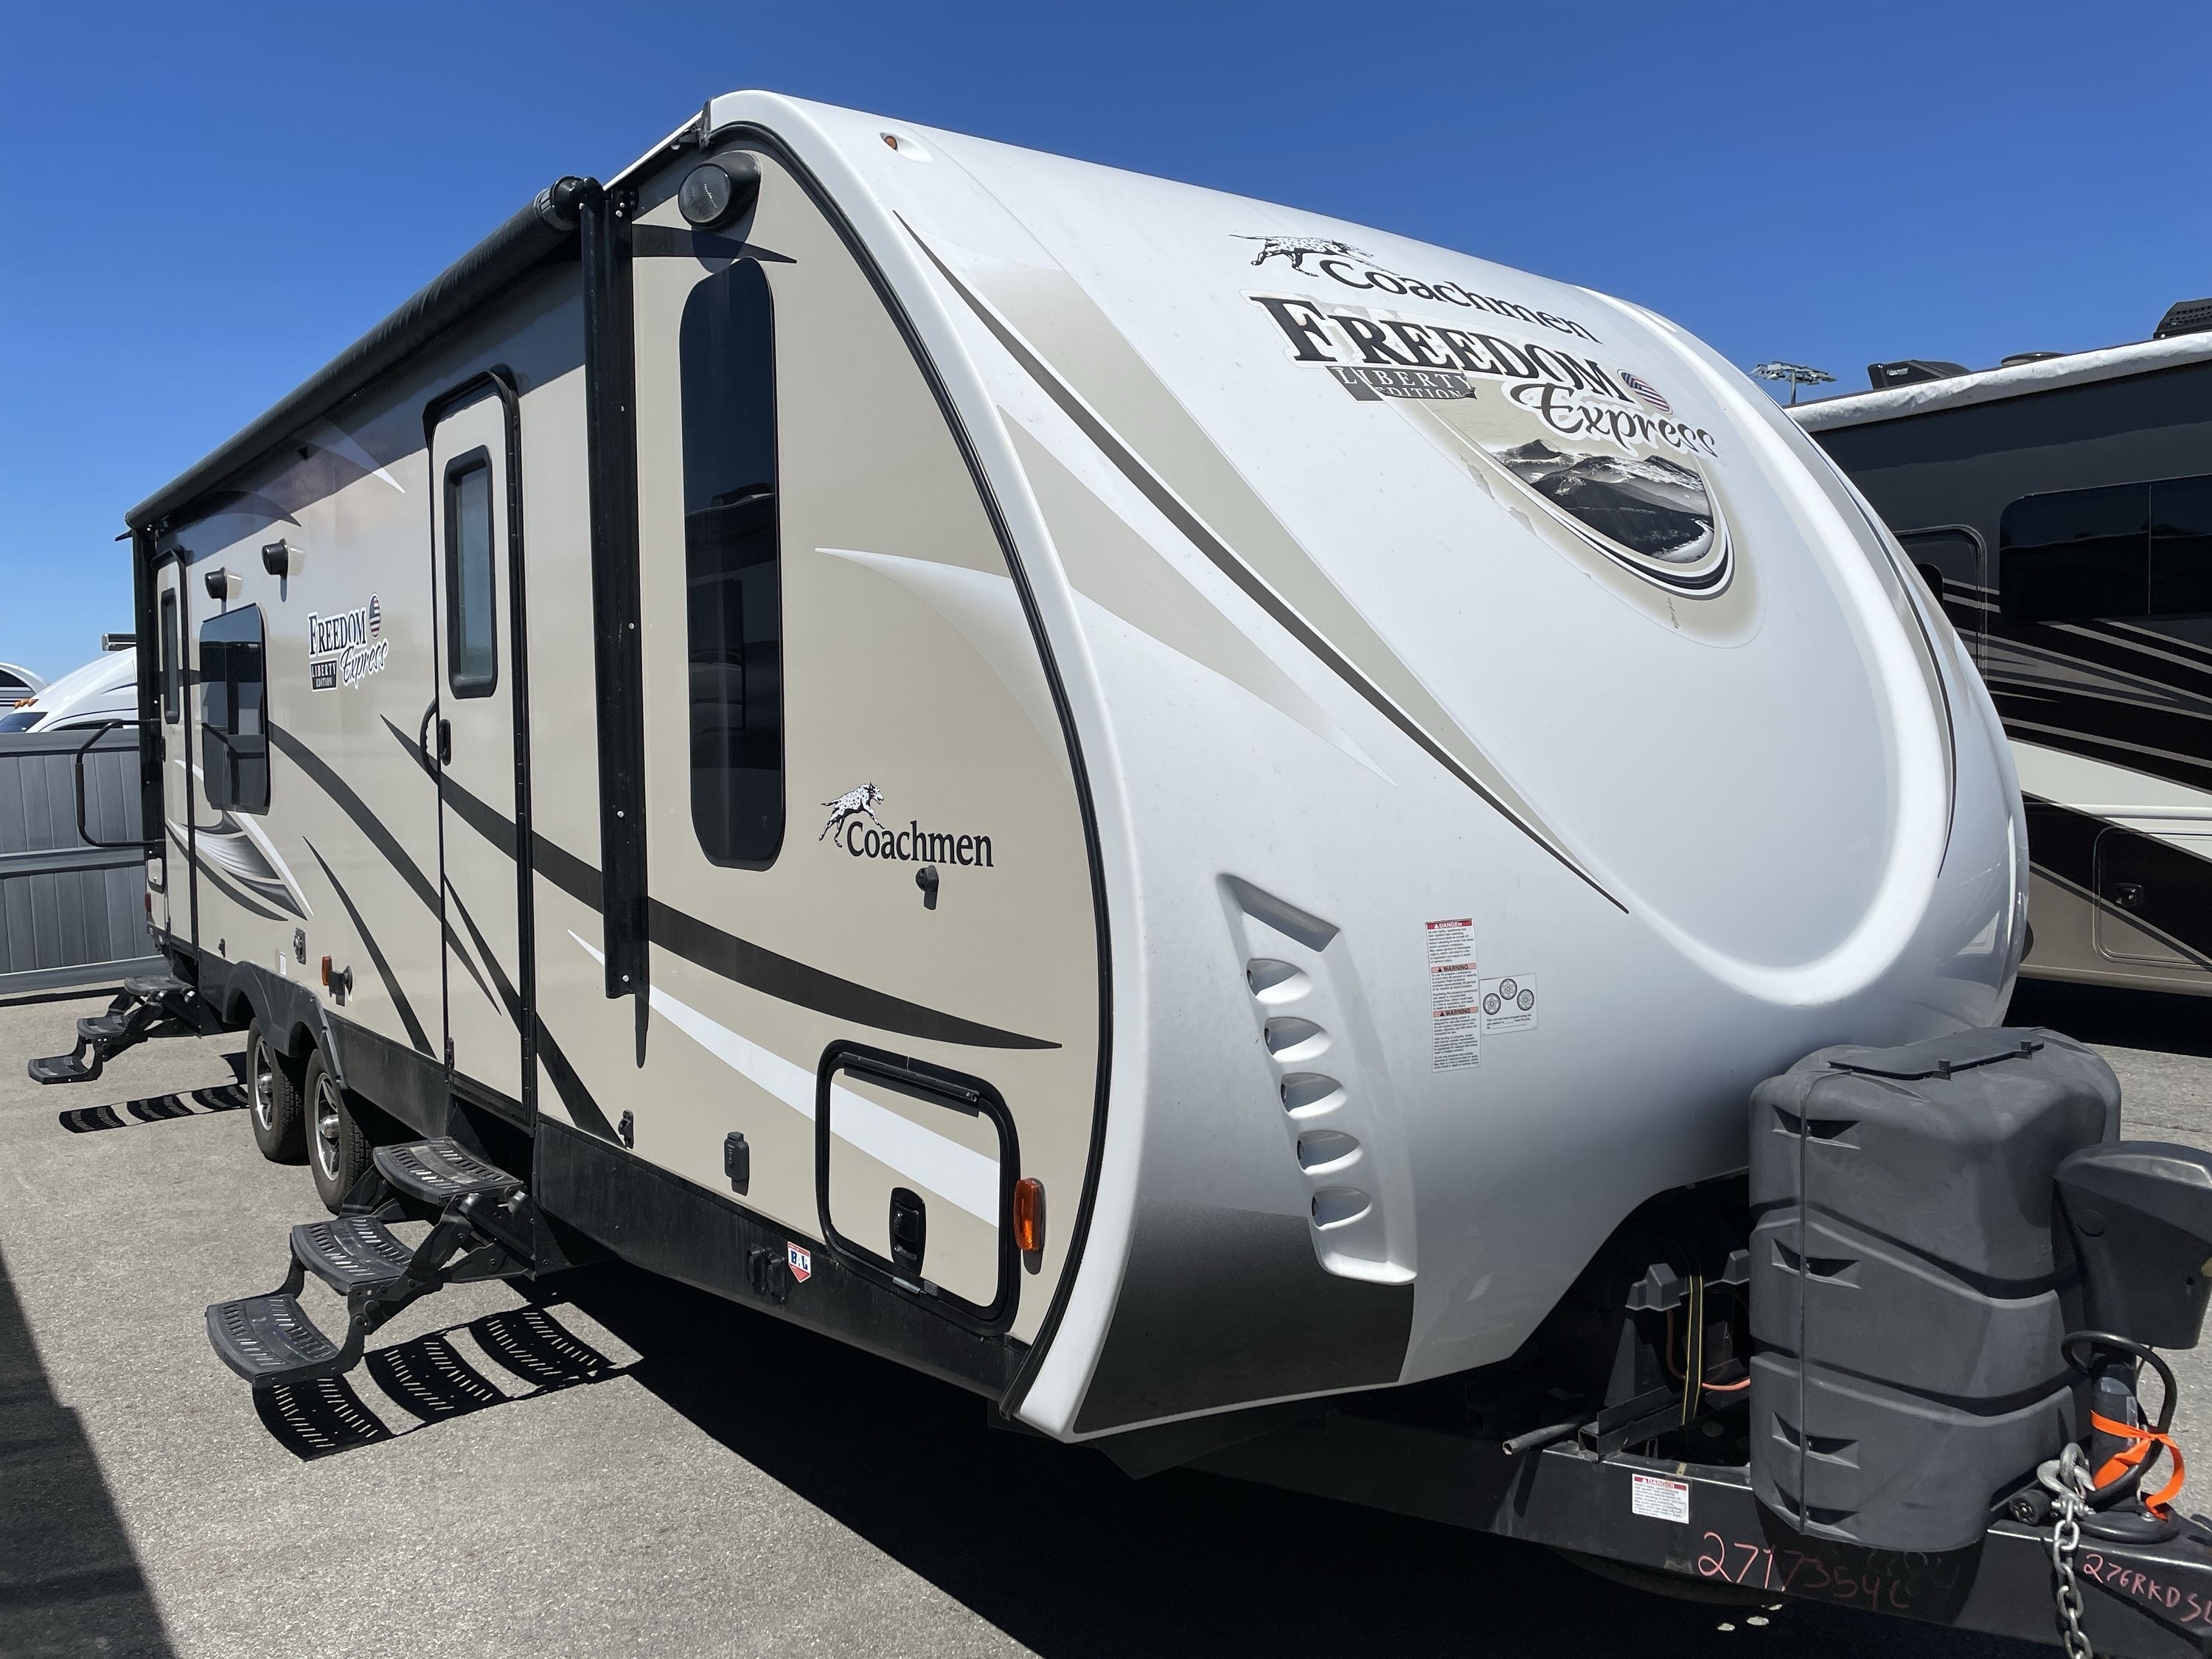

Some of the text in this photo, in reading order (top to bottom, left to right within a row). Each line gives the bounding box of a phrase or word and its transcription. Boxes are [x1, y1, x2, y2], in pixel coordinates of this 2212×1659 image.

[1320, 259, 1604, 344] Coachmen
[1248, 296, 1635, 404] FREEDOM
[1509, 382, 1719, 459] Express
[308, 610, 366, 655] FREEDOM
[311, 662, 337, 678] LIBERTY
[316, 677, 333, 688] EDITION
[340, 641, 388, 684] Express
[846, 819, 995, 868] Coachmen
[1443, 964, 1469, 972] WARNING
[1445, 1008, 1471, 1016] WARNING
[1647, 1478, 1675, 1489] DANGER
